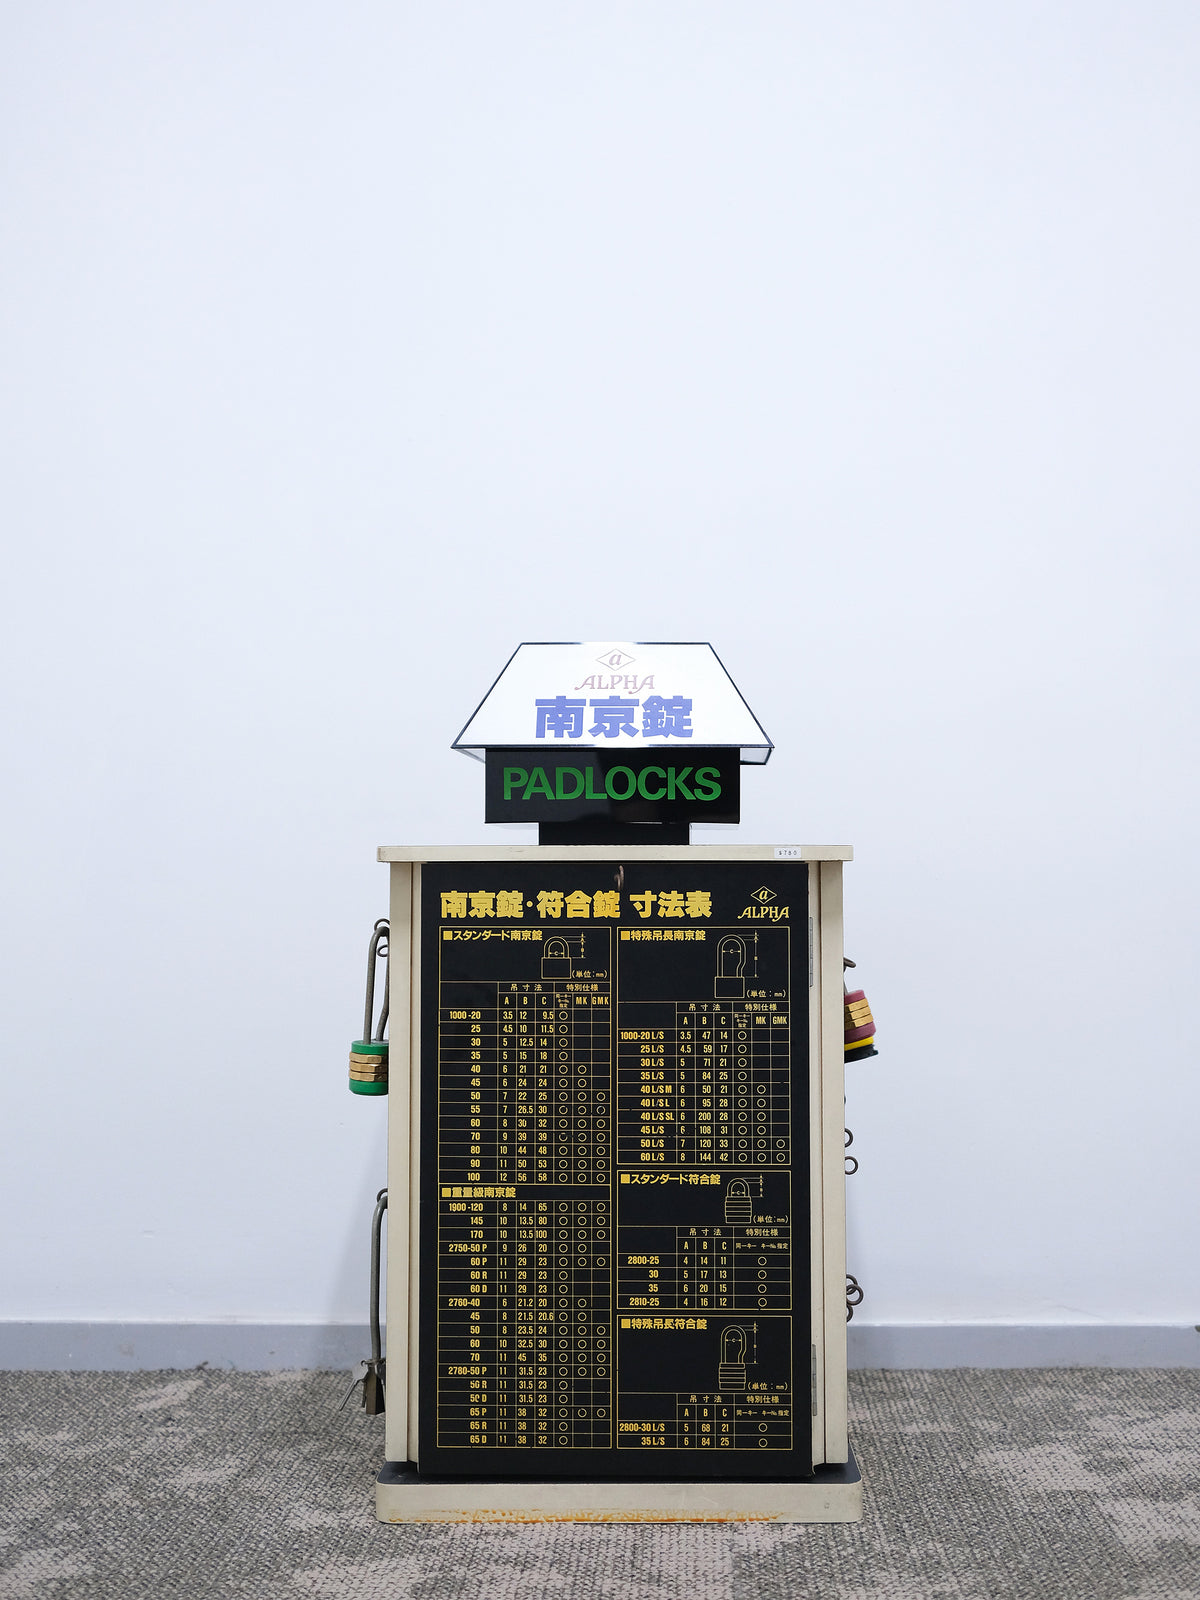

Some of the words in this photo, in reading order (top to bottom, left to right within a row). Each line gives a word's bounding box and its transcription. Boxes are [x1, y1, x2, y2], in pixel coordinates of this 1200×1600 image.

[574, 674, 654, 694] ALPHA
[534, 696, 693, 738] 南京錠
[504, 766, 721, 801] PADLOCKS
[738, 906, 790, 922] ALPHA
[504, 996, 509, 1004] A
[523, 996, 528, 1005] B
[542, 996, 546, 1005] C
[576, 996, 587, 1005] MK
[591, 996, 609, 1005] GMK
[503, 1011, 513, 1020] 3.5
[520, 1011, 527, 1020] 12
[543, 1011, 554, 1020] 9.5
[702, 1016, 707, 1024] B
[721, 1016, 726, 1024] C
[756, 1016, 766, 1024] MK
[773, 1016, 787, 1024] GMK
[471, 1024, 481, 1033] 25
[503, 1024, 513, 1033] 4.5
[520, 1024, 527, 1033] 10
[541, 1024, 554, 1033] 11.5
[680, 1031, 691, 1040] 3.5
[702, 1031, 711, 1039] 47
[720, 1031, 728, 1039] 14
[471, 1038, 481, 1046] 30
[520, 1038, 534, 1047] 12.5
[540, 1038, 547, 1046] 14
[680, 1045, 691, 1053] 4.5
[703, 1045, 712, 1053] 59
[720, 1045, 728, 1053] 17
[471, 1051, 481, 1060] 35
[520, 1052, 527, 1060] 15
[540, 1052, 547, 1060] 18
[704, 1058, 710, 1066] 71
[720, 1058, 726, 1066] 21
[471, 1065, 480, 1073] 40
[520, 1065, 526, 1073] 21
[540, 1065, 546, 1073] 21
[702, 1072, 711, 1080] 84
[719, 1072, 728, 1080] 25
[470, 1078, 480, 1087] 45
[518, 1078, 527, 1087] 24
[539, 1078, 547, 1087] 24
[702, 1085, 711, 1094] 50
[720, 1085, 728, 1094] 21
[470, 1092, 480, 1100] 50
[518, 1092, 527, 1100] 22
[539, 1092, 547, 1100] 25
[702, 1099, 711, 1107] 95
[719, 1099, 728, 1107] 28
[471, 1105, 480, 1114] 55
[518, 1105, 533, 1114] 26.5
[538, 1105, 547, 1114] 30
[698, 1112, 711, 1120] 200
[719, 1112, 728, 1120] 28
[470, 1118, 480, 1127] 60
[518, 1119, 527, 1128] 30
[538, 1119, 547, 1127] 32
[700, 1126, 711, 1134] 108
[720, 1126, 728, 1134] 31
[471, 1132, 480, 1141] 70
[518, 1132, 527, 1141] 39
[538, 1132, 547, 1141] 39
[700, 1139, 711, 1148] 120
[720, 1139, 728, 1148] 33
[470, 1145, 480, 1154] 80
[518, 1146, 527, 1154] 44
[538, 1146, 547, 1154] 48
[700, 1153, 711, 1161] 144
[720, 1153, 728, 1161] 42
[470, 1159, 480, 1168] 90
[518, 1159, 527, 1168] 50
[538, 1160, 547, 1168] 53
[468, 1173, 480, 1181] 100
[500, 1173, 507, 1181] 12
[518, 1173, 527, 1182] 56
[538, 1173, 547, 1182] 58
[520, 1203, 527, 1211] 14
[539, 1203, 547, 1211] 65
[470, 1216, 483, 1225] 145
[520, 1216, 533, 1225] 13.5
[539, 1216, 547, 1225] 80
[470, 1230, 483, 1239] 170
[520, 1230, 533, 1239] 13.5
[518, 1244, 527, 1252] 26
[539, 1244, 547, 1252] 20
[700, 1256, 708, 1265] 14
[721, 1256, 726, 1265] 11
[649, 1270, 659, 1278] 30
[700, 1270, 708, 1278] 17
[720, 1270, 727, 1278] 13
[648, 1284, 658, 1292] 35
[700, 1284, 708, 1292] 20
[720, 1284, 727, 1292] 15
[518, 1298, 533, 1307] 21.2
[538, 1298, 547, 1307] 20
[701, 1298, 708, 1306] 16
[720, 1298, 727, 1306] 12
[470, 1312, 480, 1320] 45
[518, 1312, 533, 1320] 21.5
[538, 1312, 554, 1321] 20.6
[470, 1326, 480, 1334] 50
[518, 1326, 533, 1334] 23.5
[538, 1326, 547, 1334] 24
[470, 1339, 480, 1348] 60
[518, 1339, 533, 1348] 32.5
[538, 1339, 547, 1348] 30
[470, 1353, 480, 1361] 70
[518, 1353, 527, 1362] 45
[538, 1353, 547, 1362] 35
[519, 1367, 533, 1375] 31.5
[538, 1367, 547, 1376] 23
[722, 1424, 728, 1432] 21
[702, 1437, 710, 1446] 84
[720, 1437, 729, 1446] 25
